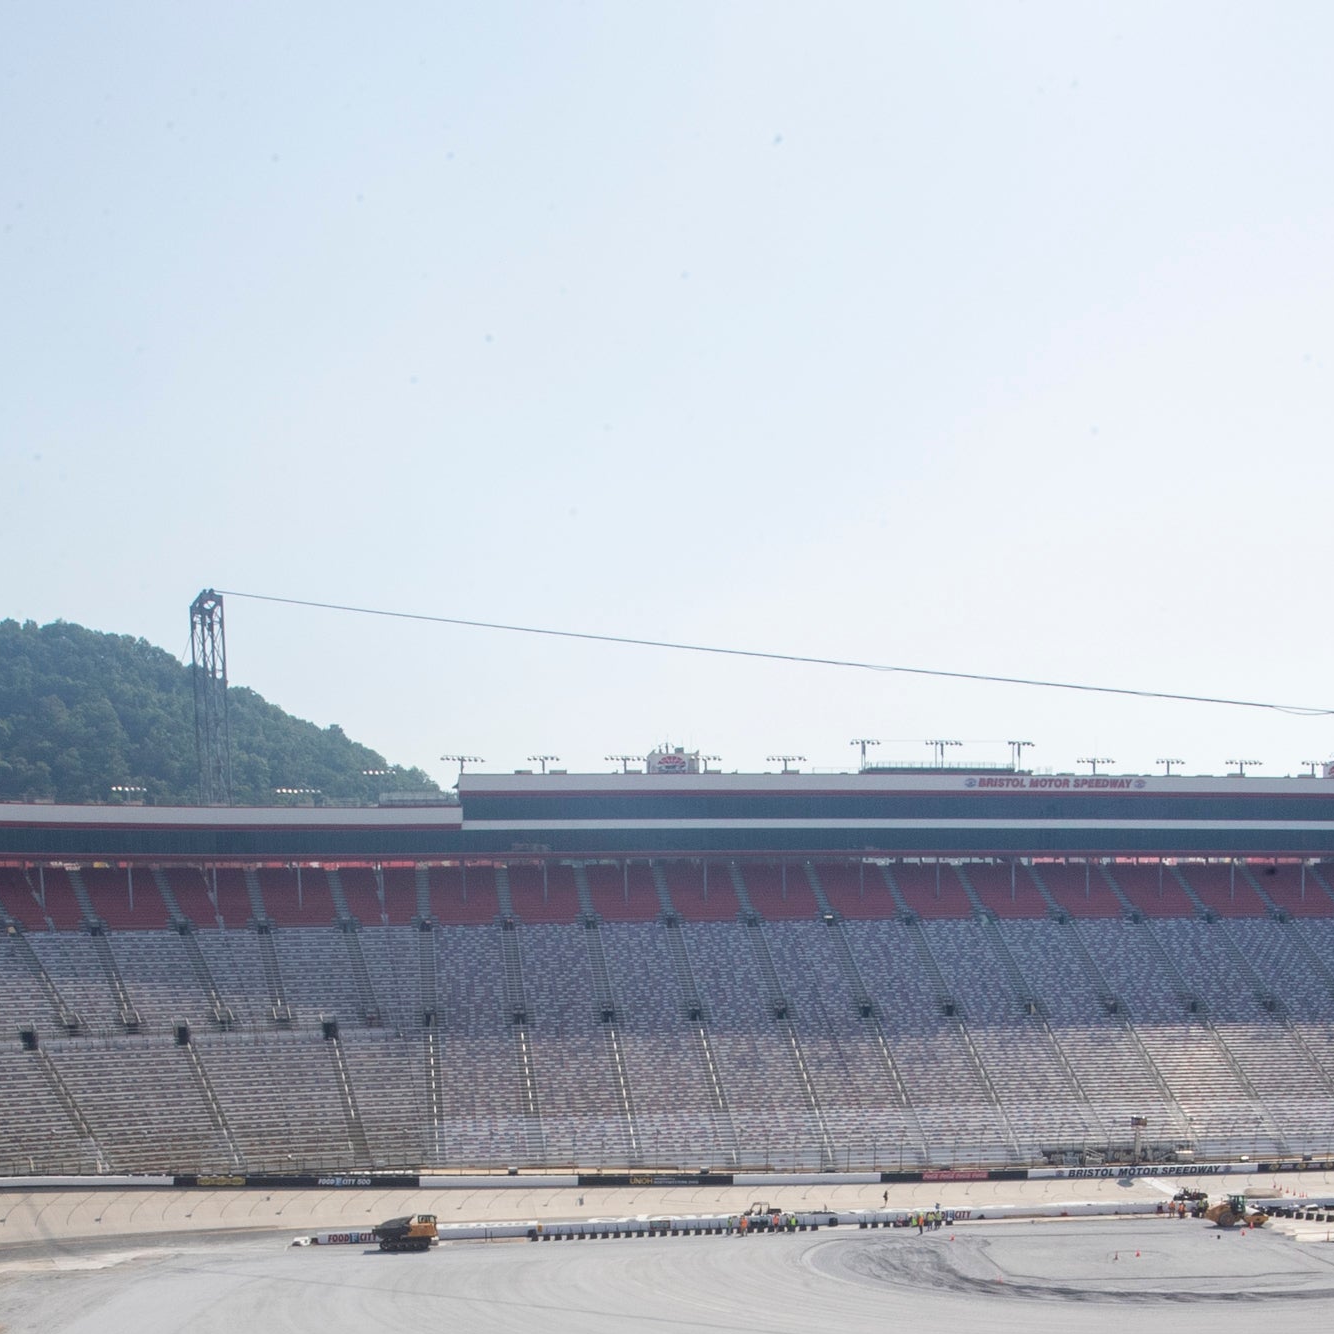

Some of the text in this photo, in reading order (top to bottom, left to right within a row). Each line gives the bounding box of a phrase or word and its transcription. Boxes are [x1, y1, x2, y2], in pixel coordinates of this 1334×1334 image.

[978, 778, 1133, 788] BRISTOL MOTOR SPEEDWAY
[1068, 1165, 1221, 1178] BRISTOL MOTOR SPEEDWAY
[630, 1177, 653, 1185] UNOH
[956, 1211, 971, 1219] CITY
[328, 1232, 377, 1243] FOOD CITY
